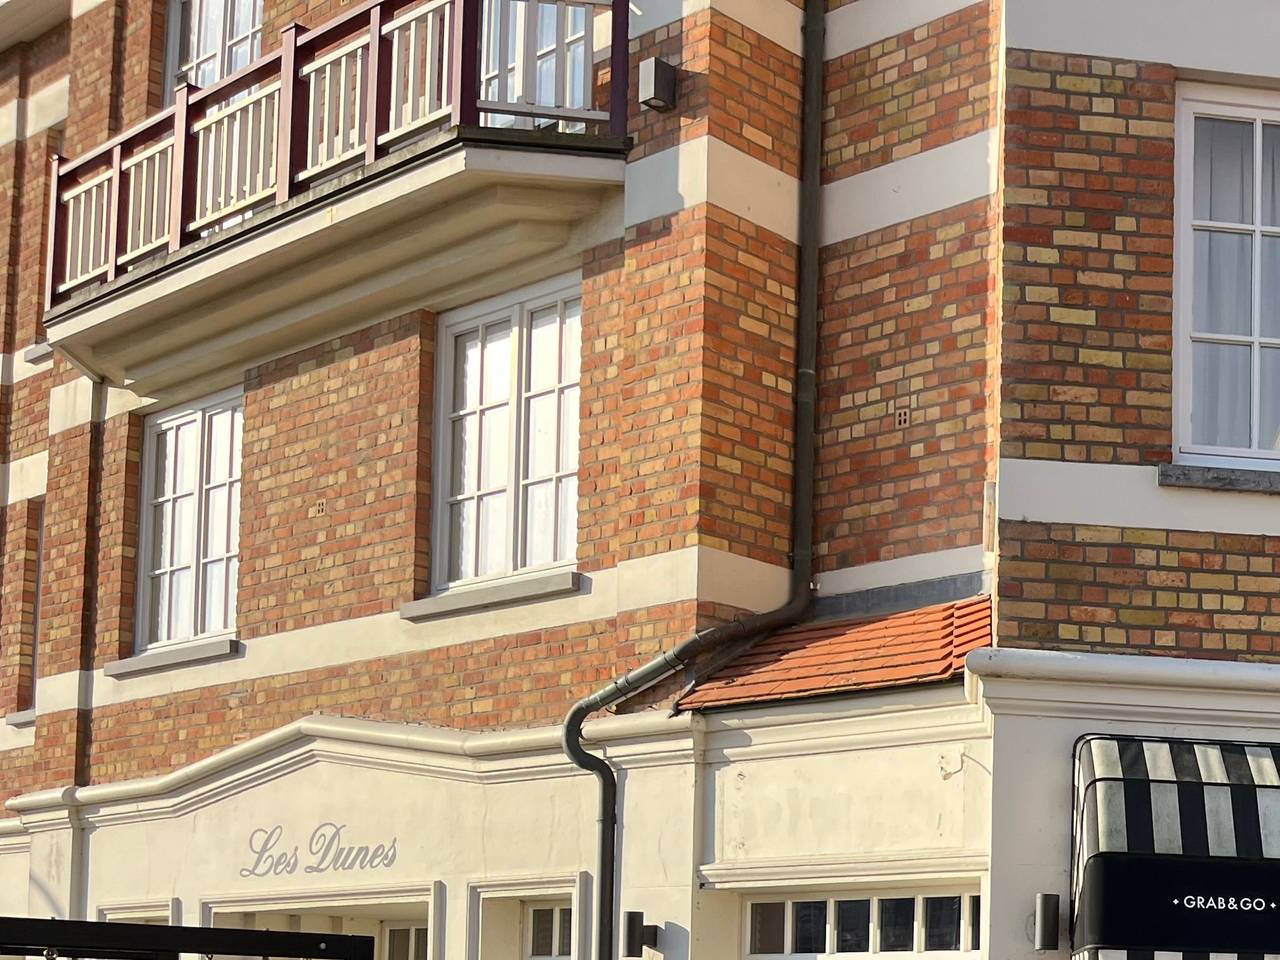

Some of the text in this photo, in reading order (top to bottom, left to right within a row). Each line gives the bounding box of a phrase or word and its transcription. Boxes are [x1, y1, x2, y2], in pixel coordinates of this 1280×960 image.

[239, 822, 397, 878] Les Dunes
[1183, 895, 1266, 911] GRAB&GO
